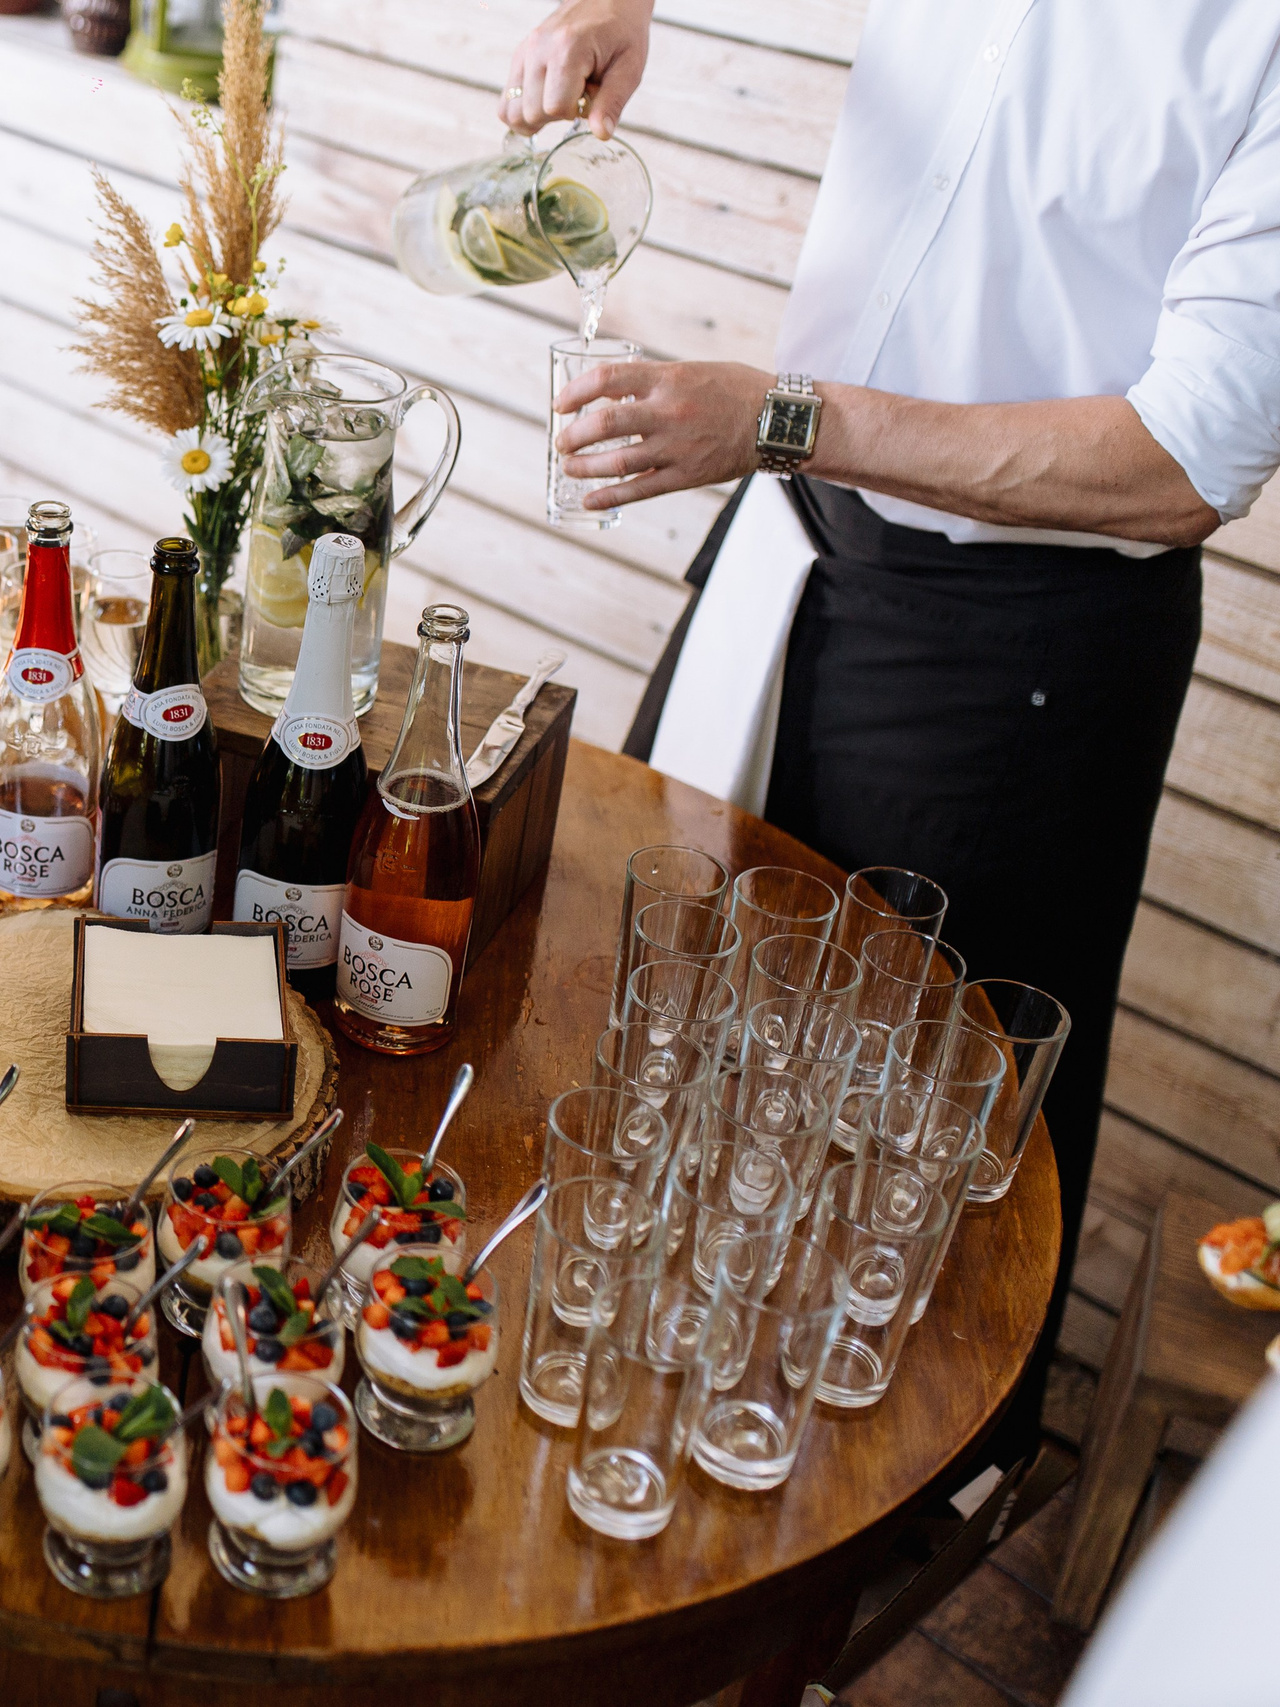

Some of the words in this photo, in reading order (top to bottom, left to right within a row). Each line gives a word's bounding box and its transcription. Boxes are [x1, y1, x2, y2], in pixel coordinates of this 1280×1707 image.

[28, 671, 47, 681] 1831
[151, 701, 164, 712] CASA
[165, 694, 191, 704] FONDATA
[170, 707, 188, 719] 1831
[152, 719, 168, 731] LUIGI
[169, 724, 189, 732] BOSCA
[290, 723, 303, 733] CASA
[305, 723, 333, 731] FONDATA
[332, 728, 343, 737] NEL
[288, 740, 301, 754] LUIGI
[301, 751, 322, 760] BOSCA
[306, 736, 325, 747] 1831
[3, 859, 49, 878] ROSE
[132, 883, 204, 908] BOSCA
[126, 906, 158, 918] ANNA
[163, 900, 207, 918] FEDERICA
[343, 944, 413, 990] BOSCA
[349, 971, 393, 1002] ROSE
